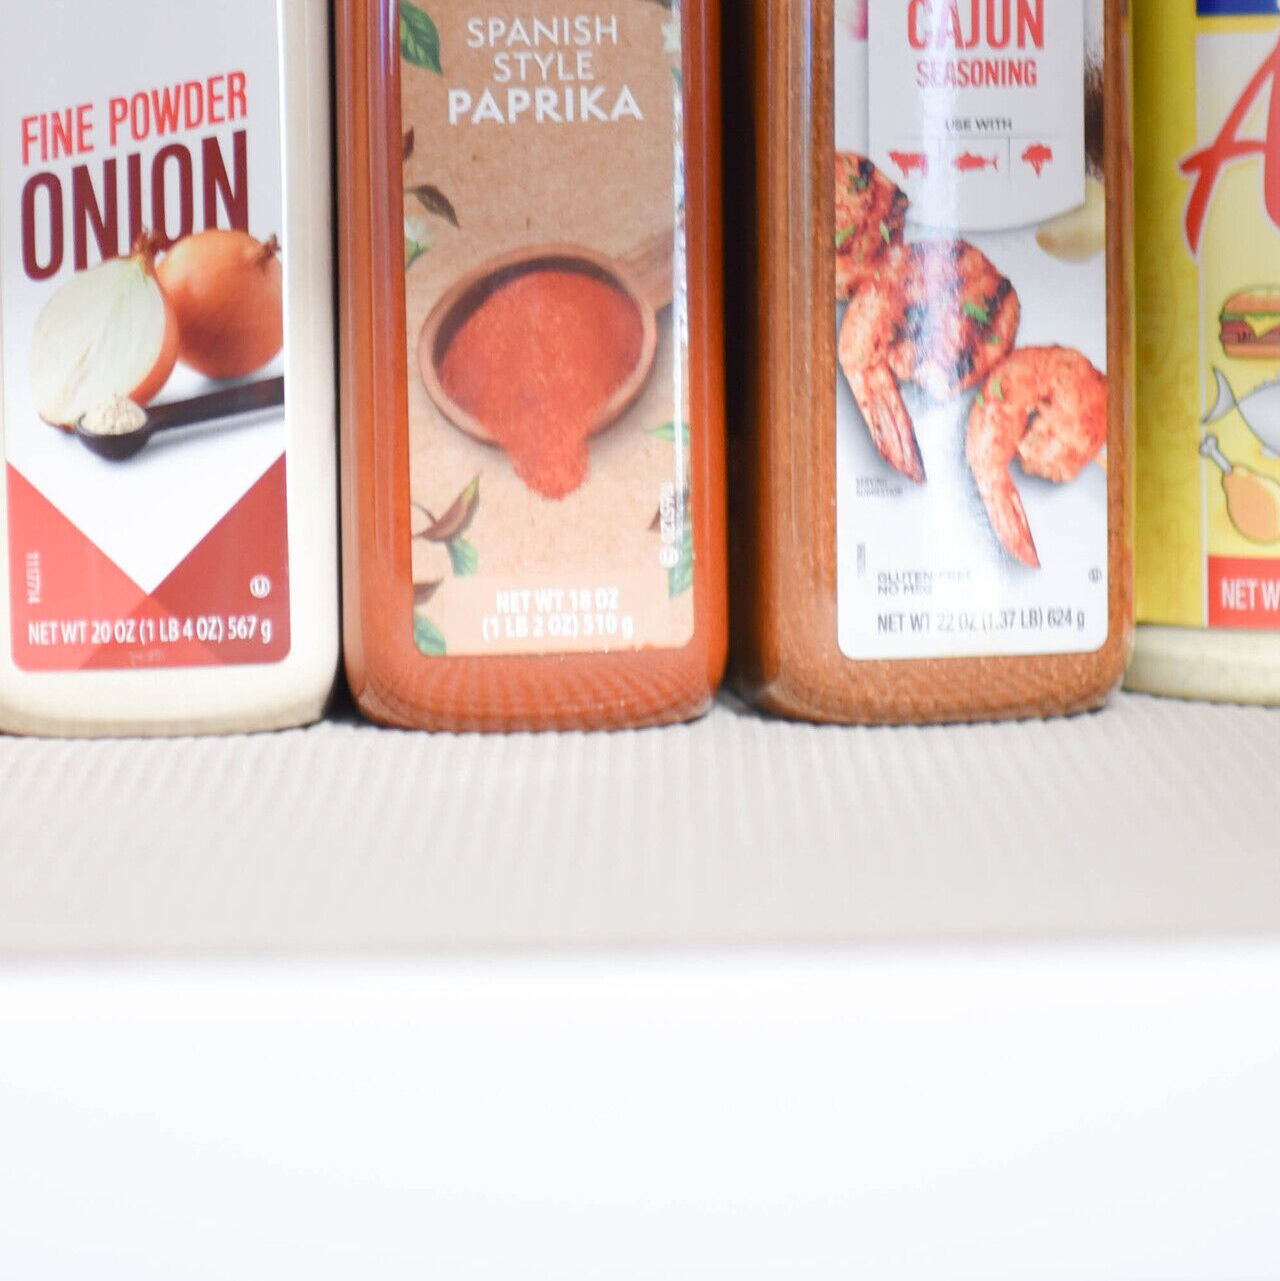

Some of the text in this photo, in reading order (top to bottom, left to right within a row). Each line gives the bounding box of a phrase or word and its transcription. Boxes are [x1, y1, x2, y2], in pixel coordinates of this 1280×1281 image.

[467, 14, 619, 49] SPANISH
[493, 50, 595, 83] STYLE
[916, 59, 1038, 88] SEASONING
[21, 71, 248, 166] FINE POWDER
[448, 84, 645, 126] PAPRIKA
[20, 130, 250, 282] ONION
[495, 589, 531, 615] NET
[534, 589, 564, 614] WT
[595, 586, 620, 611] OZ
[1220, 579, 1258, 611] NET
[28, 615, 273, 646] NET WT 20 OZ (1 LB 4 OZ) 567 g
[877, 612, 905, 634] NET
